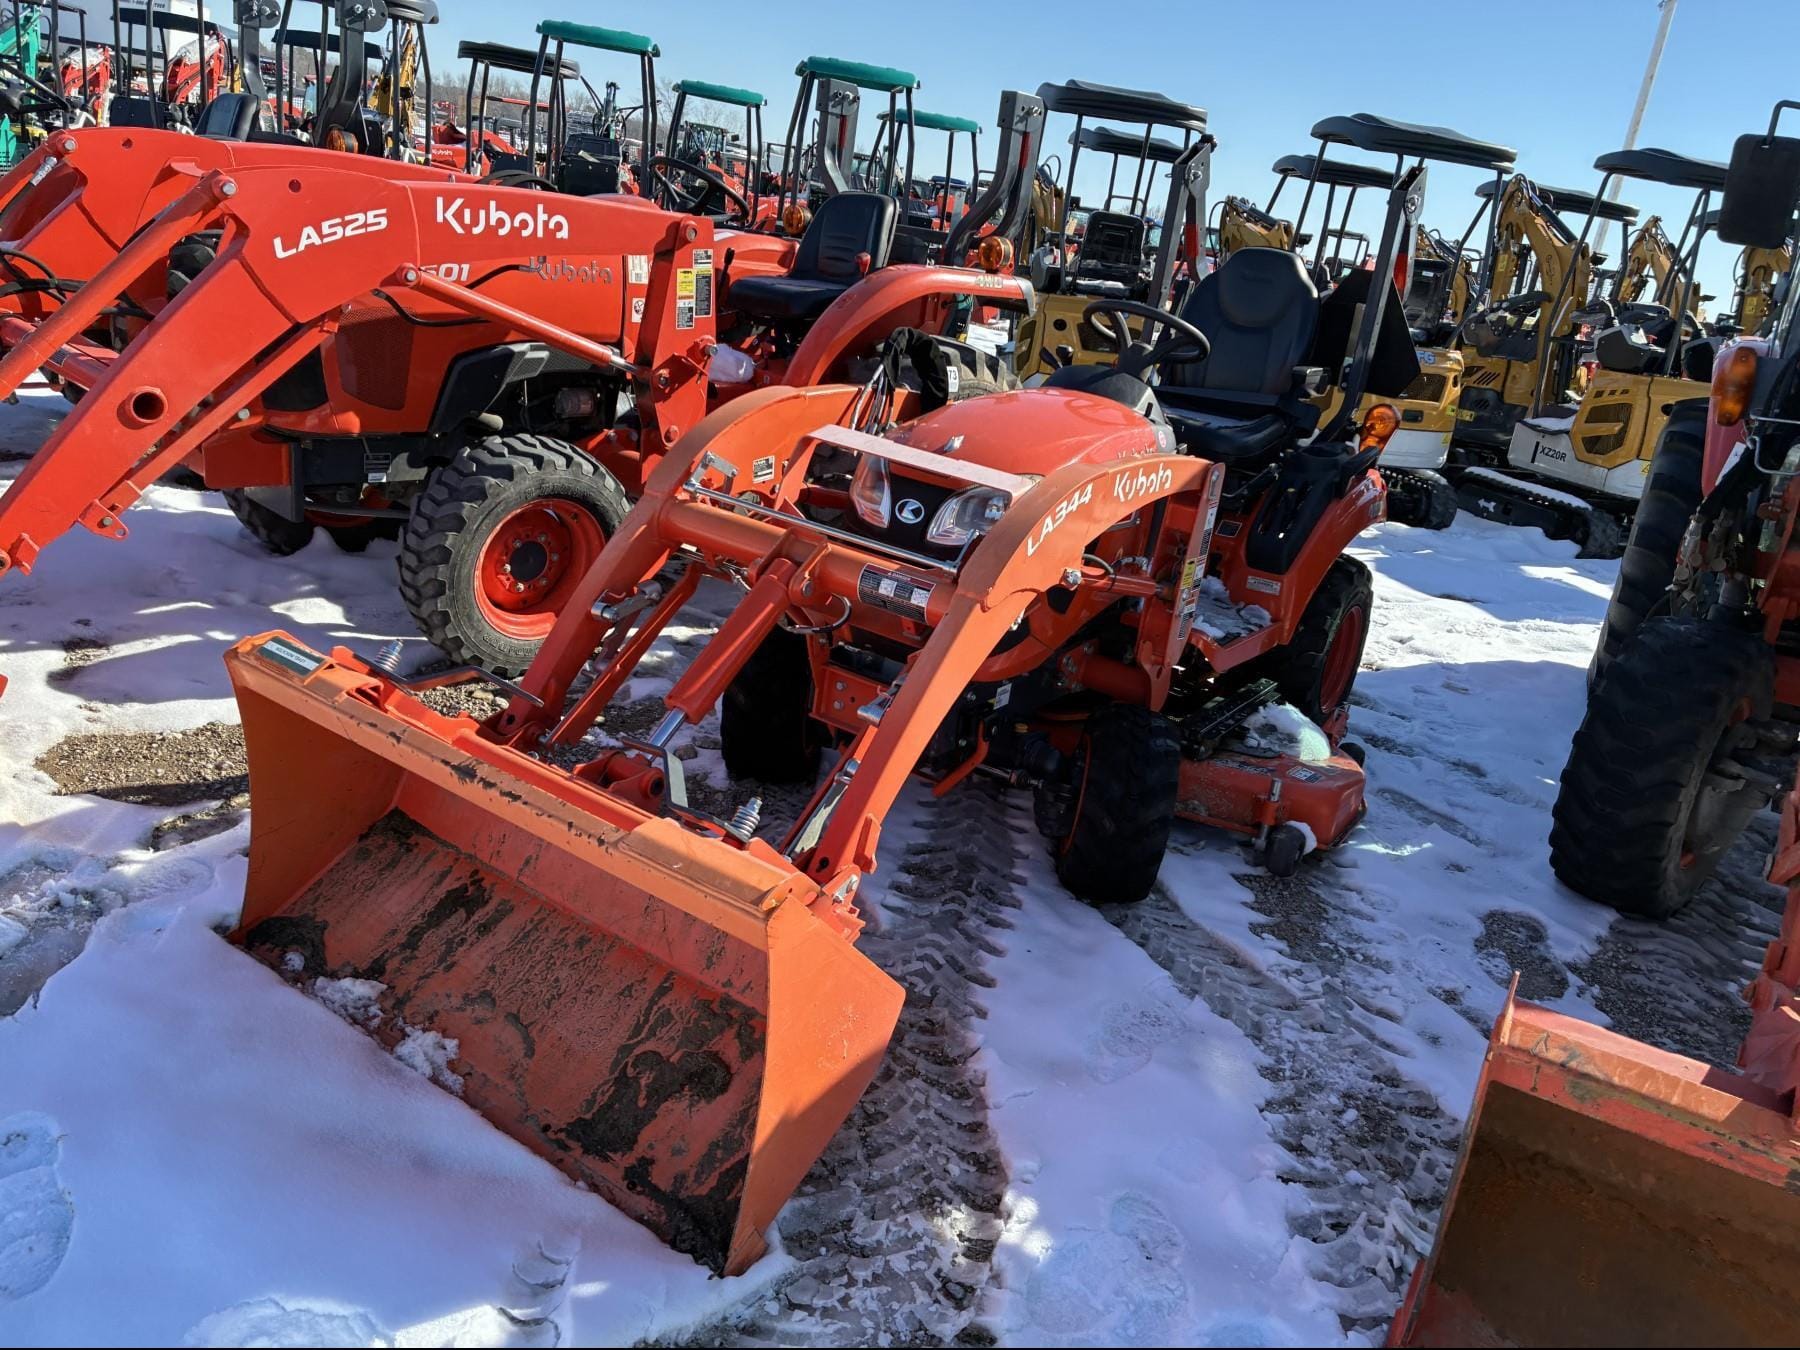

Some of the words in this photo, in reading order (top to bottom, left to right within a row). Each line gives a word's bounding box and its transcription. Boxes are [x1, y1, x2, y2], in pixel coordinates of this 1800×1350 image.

[273, 208, 389, 260] LA525
[436, 196, 569, 240] Kubota
[529, 255, 613, 285] Kubota
[975, 275, 1004, 289] 4WD
[1539, 445, 1567, 463] XZ20R
[1113, 462, 1173, 503] Kubota
[1026, 482, 1094, 557] LA344
